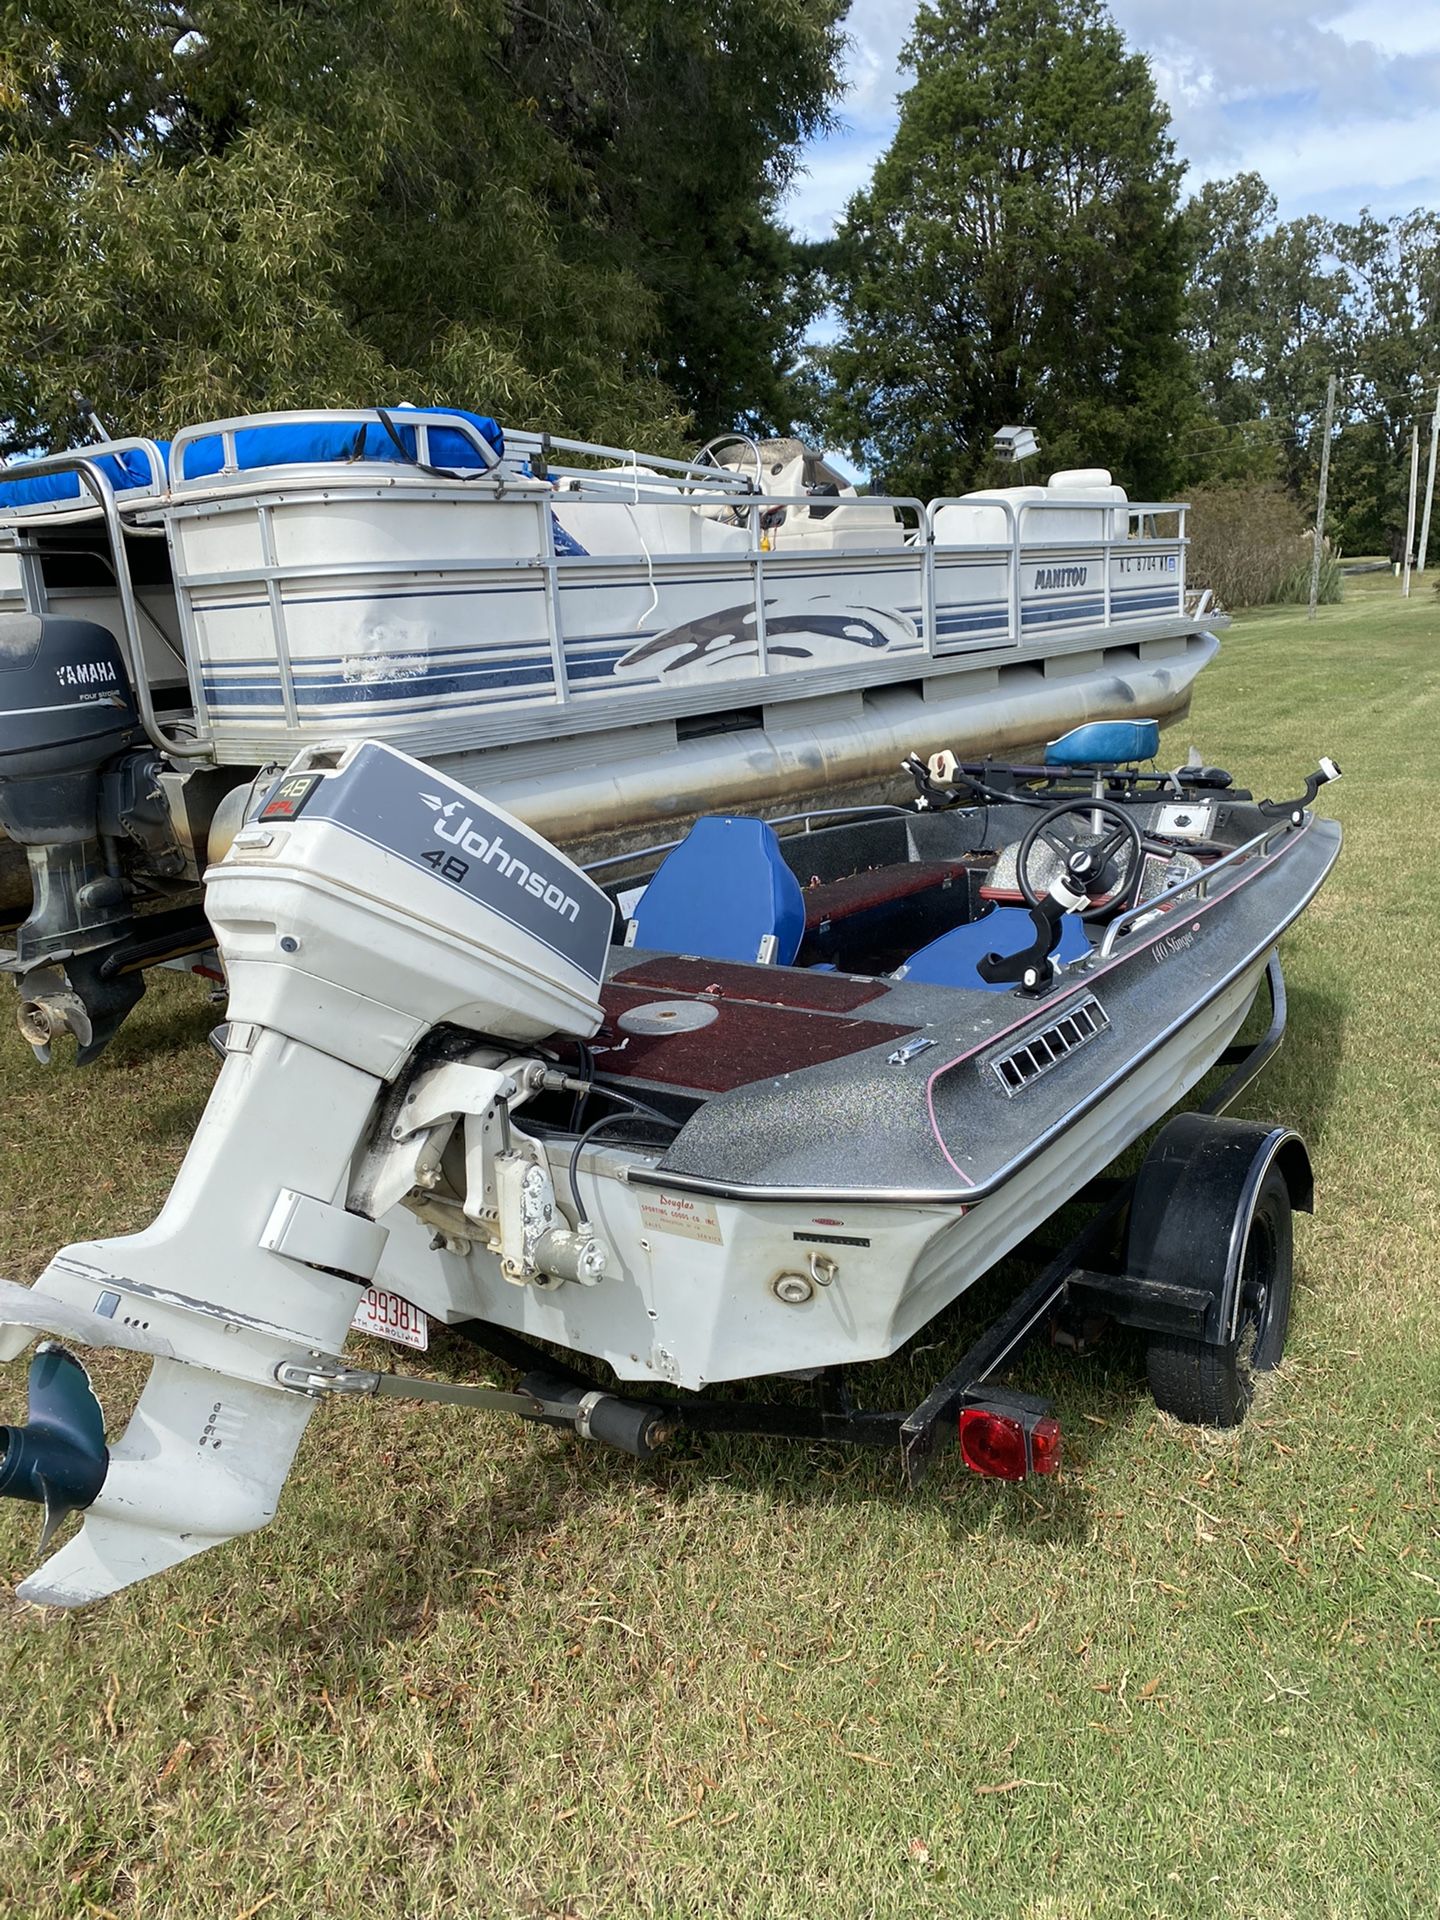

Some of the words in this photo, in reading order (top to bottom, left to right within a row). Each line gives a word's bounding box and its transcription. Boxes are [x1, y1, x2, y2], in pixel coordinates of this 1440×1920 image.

[1034, 567, 1088, 590] MANITOU
[56, 661, 117, 686] YAMAHA
[279, 778, 312, 797] 48
[262, 800, 296, 816] SPL
[420, 850, 470, 884] 48
[433, 816, 581, 923] Johnson
[1166, 931, 1194, 954] Stinger
[641, 1204, 668, 1216] SPORTING
[671, 1210, 689, 1221] GOODS
[660, 1194, 695, 1210] Douglas
[373, 1323, 420, 1344] CAROLINA
